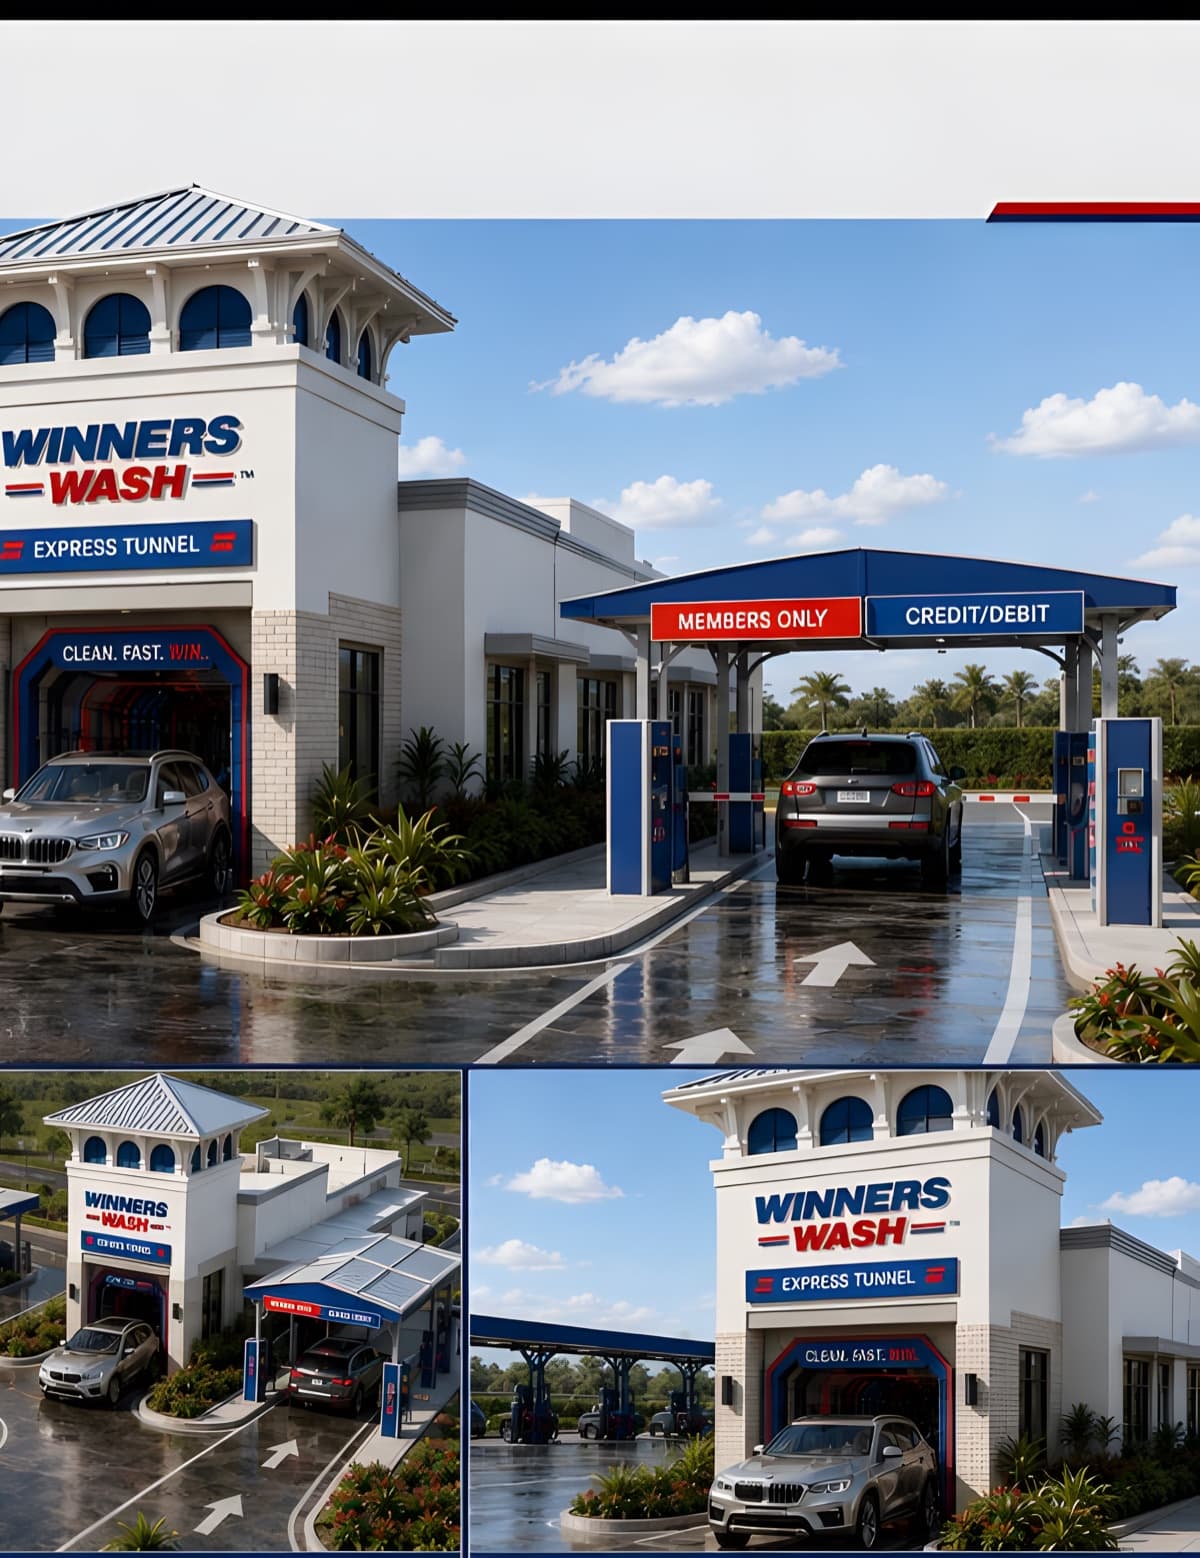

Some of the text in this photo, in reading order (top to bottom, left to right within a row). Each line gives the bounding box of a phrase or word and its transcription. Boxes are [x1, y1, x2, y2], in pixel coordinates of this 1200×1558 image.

[1, 415, 242, 467] WINNERS
[50, 464, 188, 505] WASH
[34, 535, 200, 558] EXPRESS TUNNEL
[678, 608, 828, 630] MEMBERS ONLY
[905, 604, 1050, 625] CREDIT/DEBIT
[63, 645, 117, 661] CLEAN.
[123, 644, 164, 660] FAST.
[85, 1190, 168, 1218] WINNERS
[755, 1177, 952, 1224] WINNERS
[102, 1211, 149, 1232] WASH
[794, 1217, 908, 1252] WASH
[782, 1270, 916, 1292] EXPRESS TUNNEL
